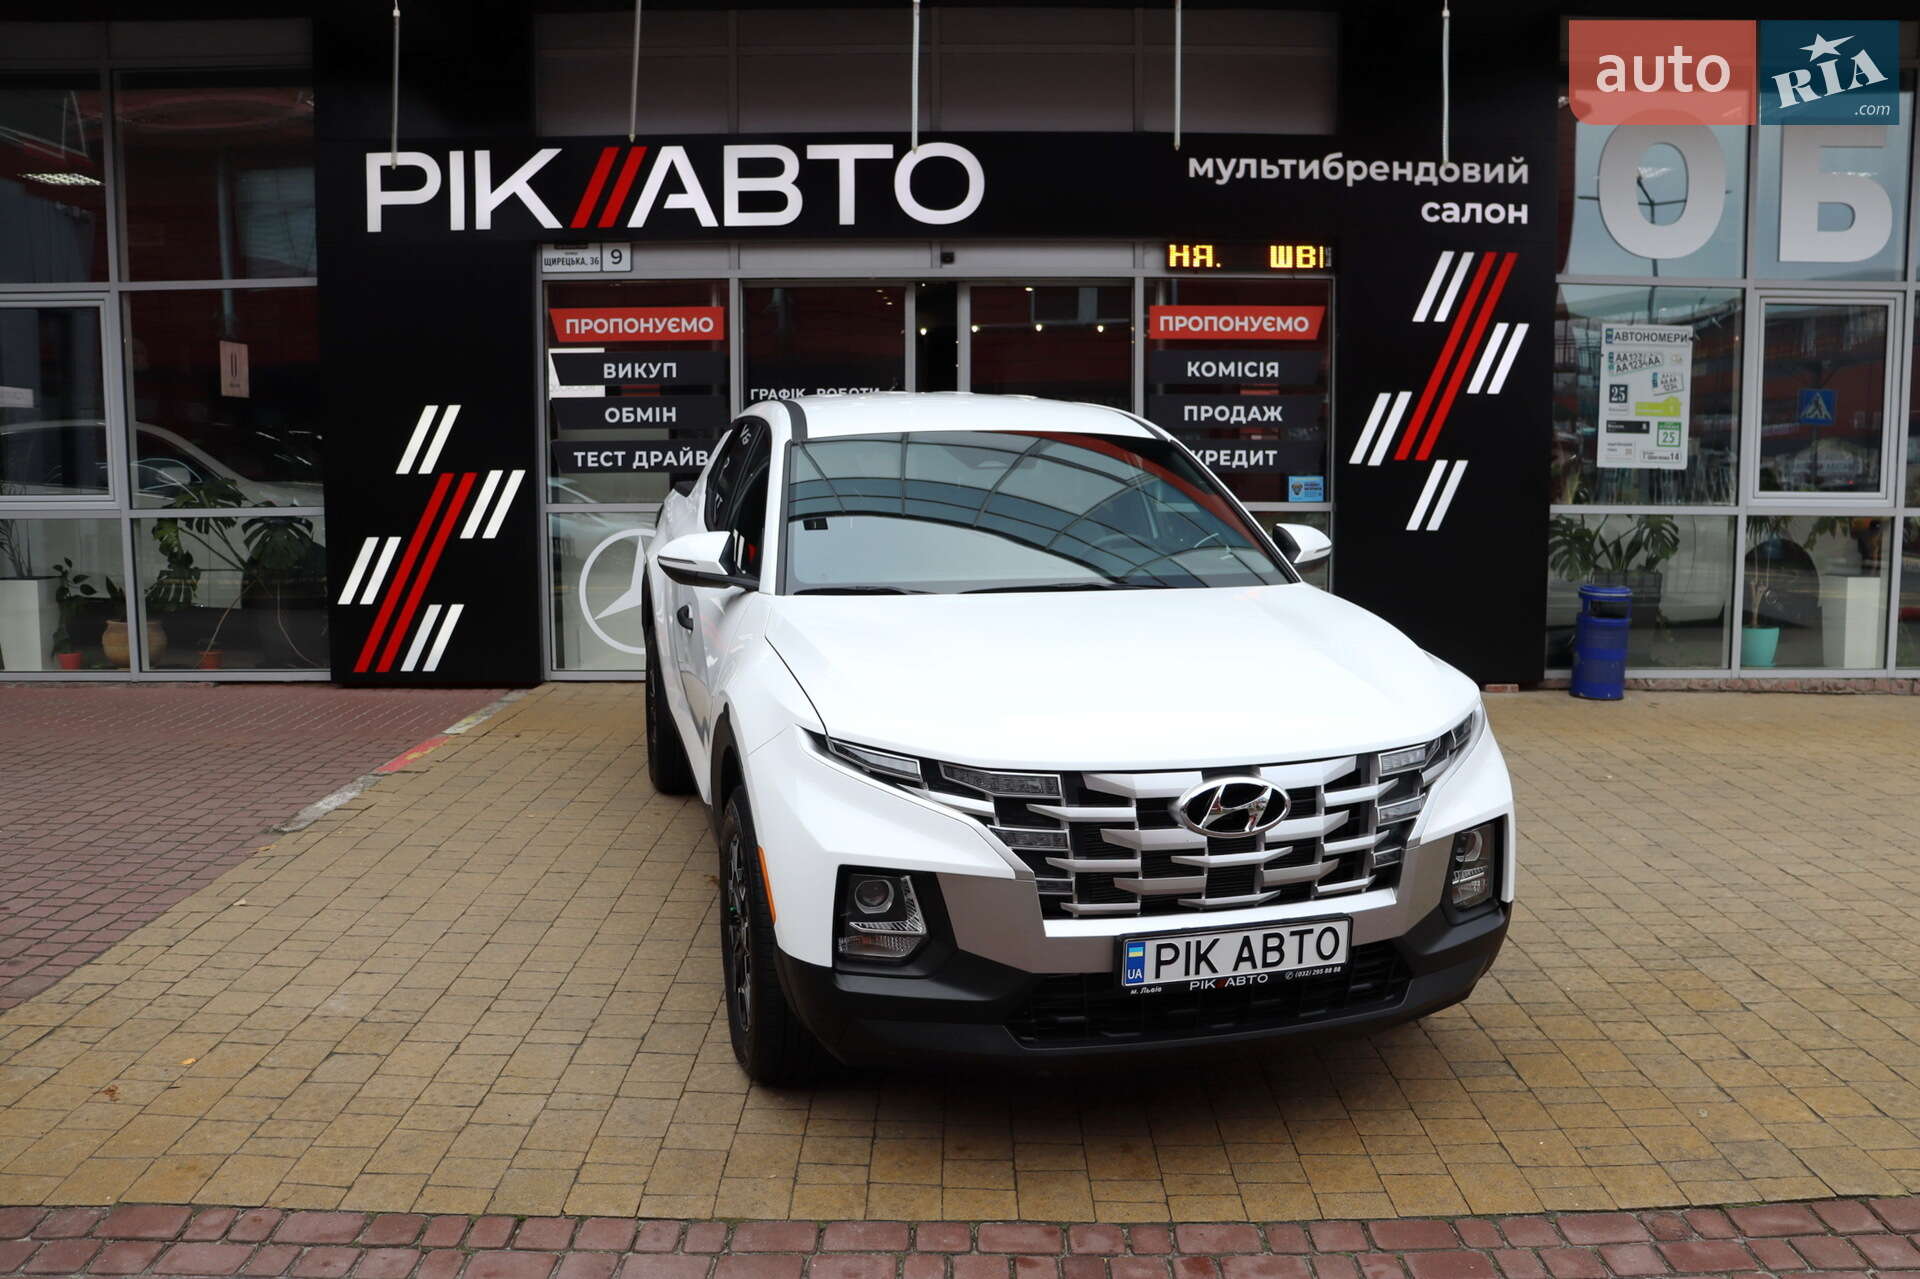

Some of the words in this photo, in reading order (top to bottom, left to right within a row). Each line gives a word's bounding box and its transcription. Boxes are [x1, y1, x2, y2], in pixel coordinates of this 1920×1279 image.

[1188, 152, 1529, 187] мультибрендовий
[1421, 201, 1529, 224] салон
[590, 256, 600, 265] 36
[610, 248, 623, 265] 9
[565, 316, 714, 335] ПРОПОНУЄМО
[1159, 315, 1309, 333] ПРОПОНУЄМО
[1614, 330, 1688, 343] АВТОНОМЕРИ
[603, 362, 678, 379] ВИКУП
[1186, 361, 1280, 378] КОМІСІЯ
[750, 388, 807, 400] ГРАФІК
[1611, 386, 1626, 401] 25
[604, 407, 677, 423] ОБМІН
[1183, 405, 1284, 425] ПРОДАЖ
[1663, 432, 1675, 443] 25
[573, 451, 626, 468] ТЕСТ
[633, 447, 709, 470] ДРАЙВ
[1127, 968, 1143, 980] UA
